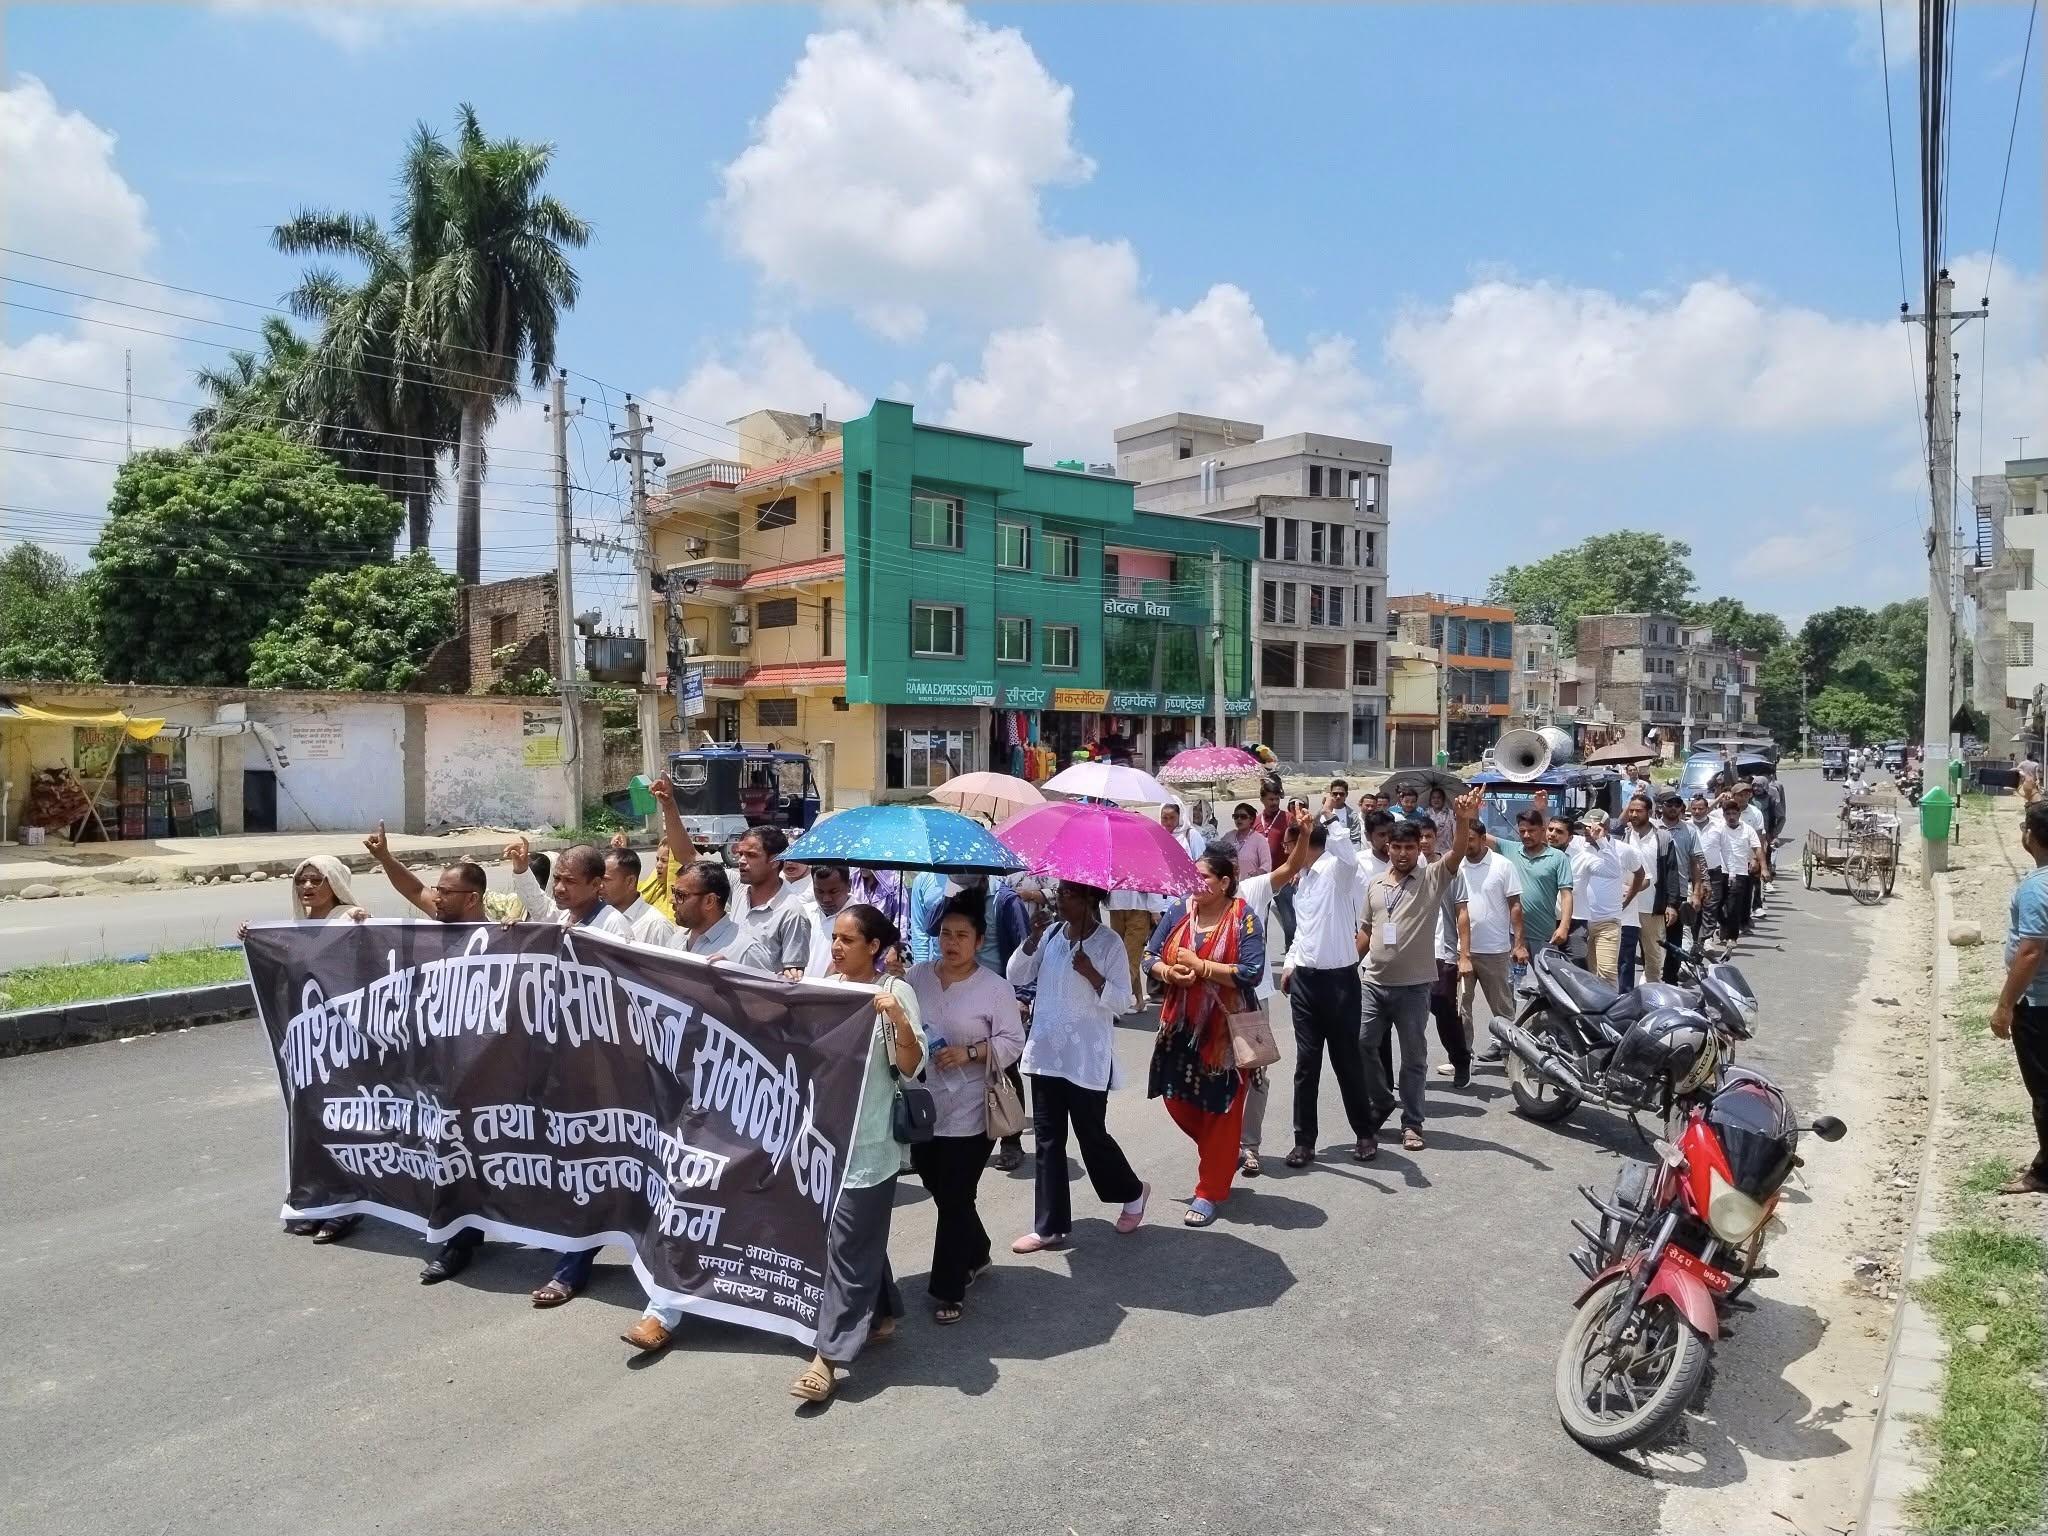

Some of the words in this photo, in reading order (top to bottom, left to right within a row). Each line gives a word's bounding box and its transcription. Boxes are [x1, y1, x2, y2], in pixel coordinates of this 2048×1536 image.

[1104, 599, 1138, 614] होटल
[1144, 601, 1171, 617] विद्या
[471, 1103, 536, 1143] तथा
[557, 1154, 644, 1206] मुलक
[750, 1265, 799, 1291] स्थानीय
